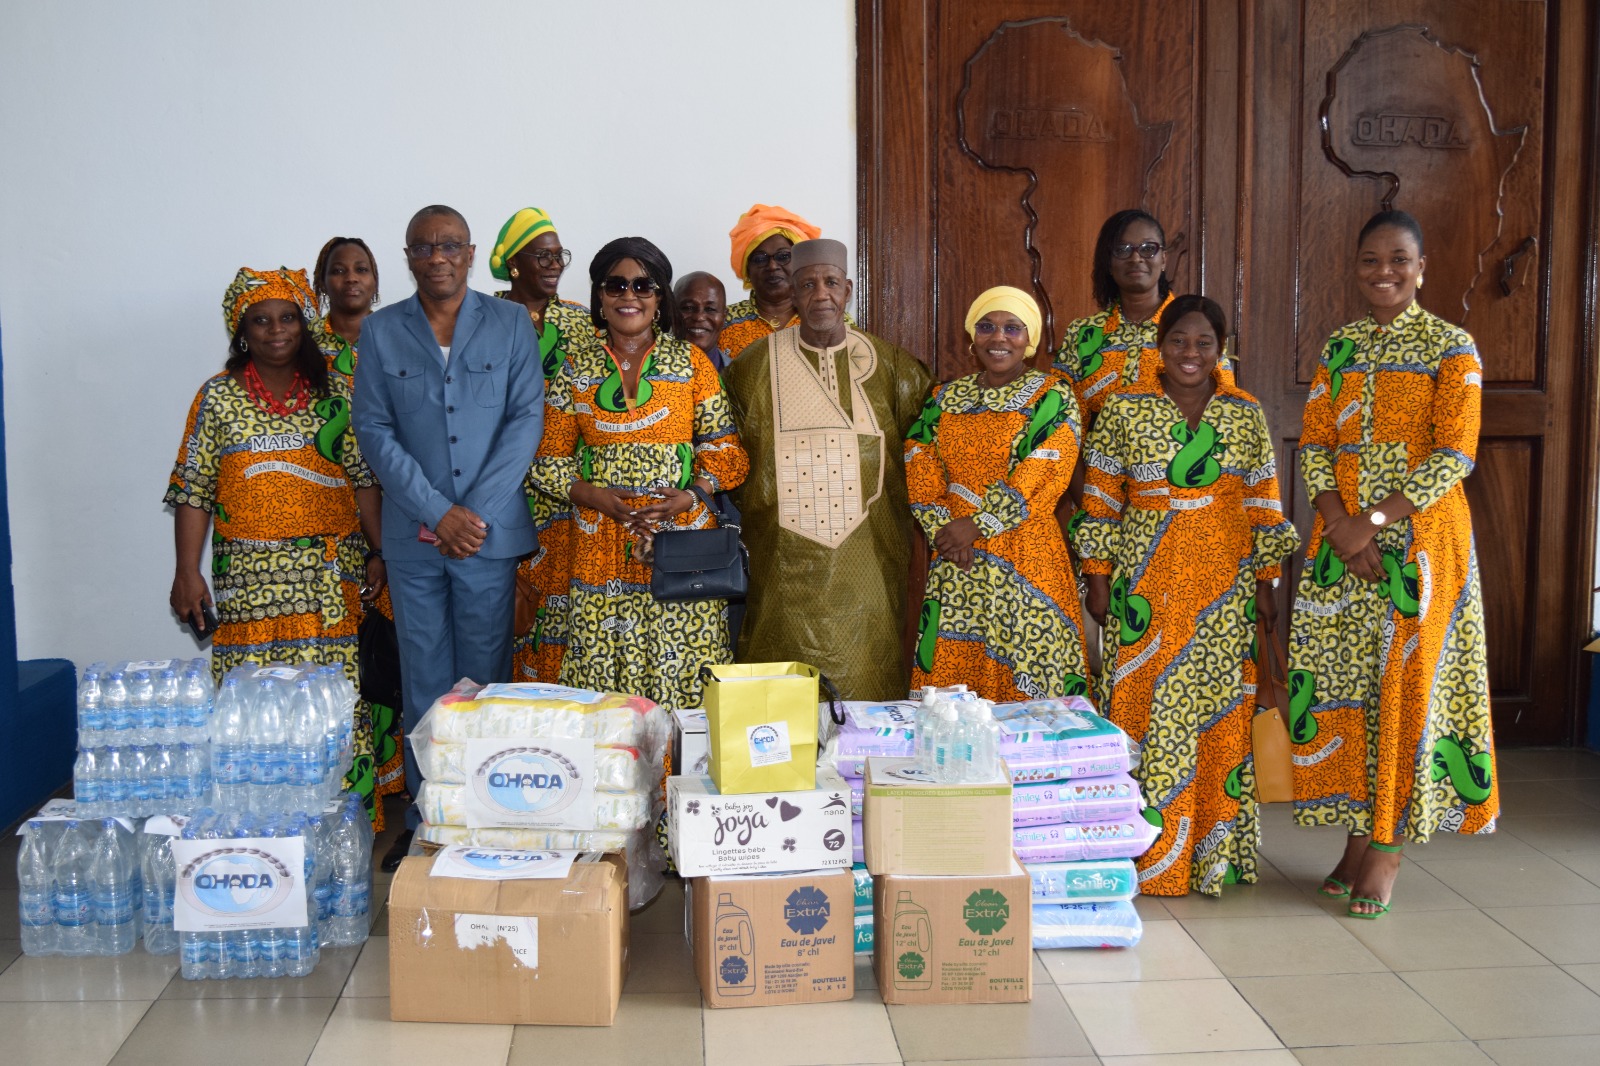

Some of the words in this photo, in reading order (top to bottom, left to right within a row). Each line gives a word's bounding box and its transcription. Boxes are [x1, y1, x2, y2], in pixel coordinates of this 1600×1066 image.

[1352, 114, 1468, 149] OHADA
[1007, 377, 1045, 411] MARS
[636, 419, 645, 428] LA
[648, 407, 668, 424] FEMME
[253, 433, 304, 451] MARS
[245, 461, 276, 478] JOURNEE
[281, 462, 334, 486] INTERNATIONALE
[1200, 498, 1209, 507] LA
[1312, 754, 1322, 762] LA
[1322, 737, 1342, 756] FEMME
[489, 772, 563, 789] OHADA
[725, 802, 741, 811] baby
[742, 803, 754, 812] joy
[1178, 817, 1189, 840] FEMME
[828, 840, 840, 849] 72
[1196, 824, 1226, 860] MARS
[718, 854, 737, 862] Baby
[738, 854, 760, 862] wipes
[195, 873, 273, 889] OHADA
[1072, 877, 1119, 891] Smiley
[786, 906, 829, 918] ExtrA
[965, 908, 1007, 918] ExtrA
[727, 943, 737, 951] chl
[780, 938, 798, 948] Eau
[799, 938, 810, 947] de
[810, 935, 836, 947] Javel
[907, 939, 917, 947] chl
[958, 938, 976, 947] Eau
[977, 938, 989, 946] de
[989, 937, 1014, 948] Javel
[797, 948, 806, 957] 8°
[807, 948, 820, 956] chl
[973, 949, 987, 957] 12°
[988, 948, 1000, 956] chl
[812, 976, 847, 984] BOUTEILLE
